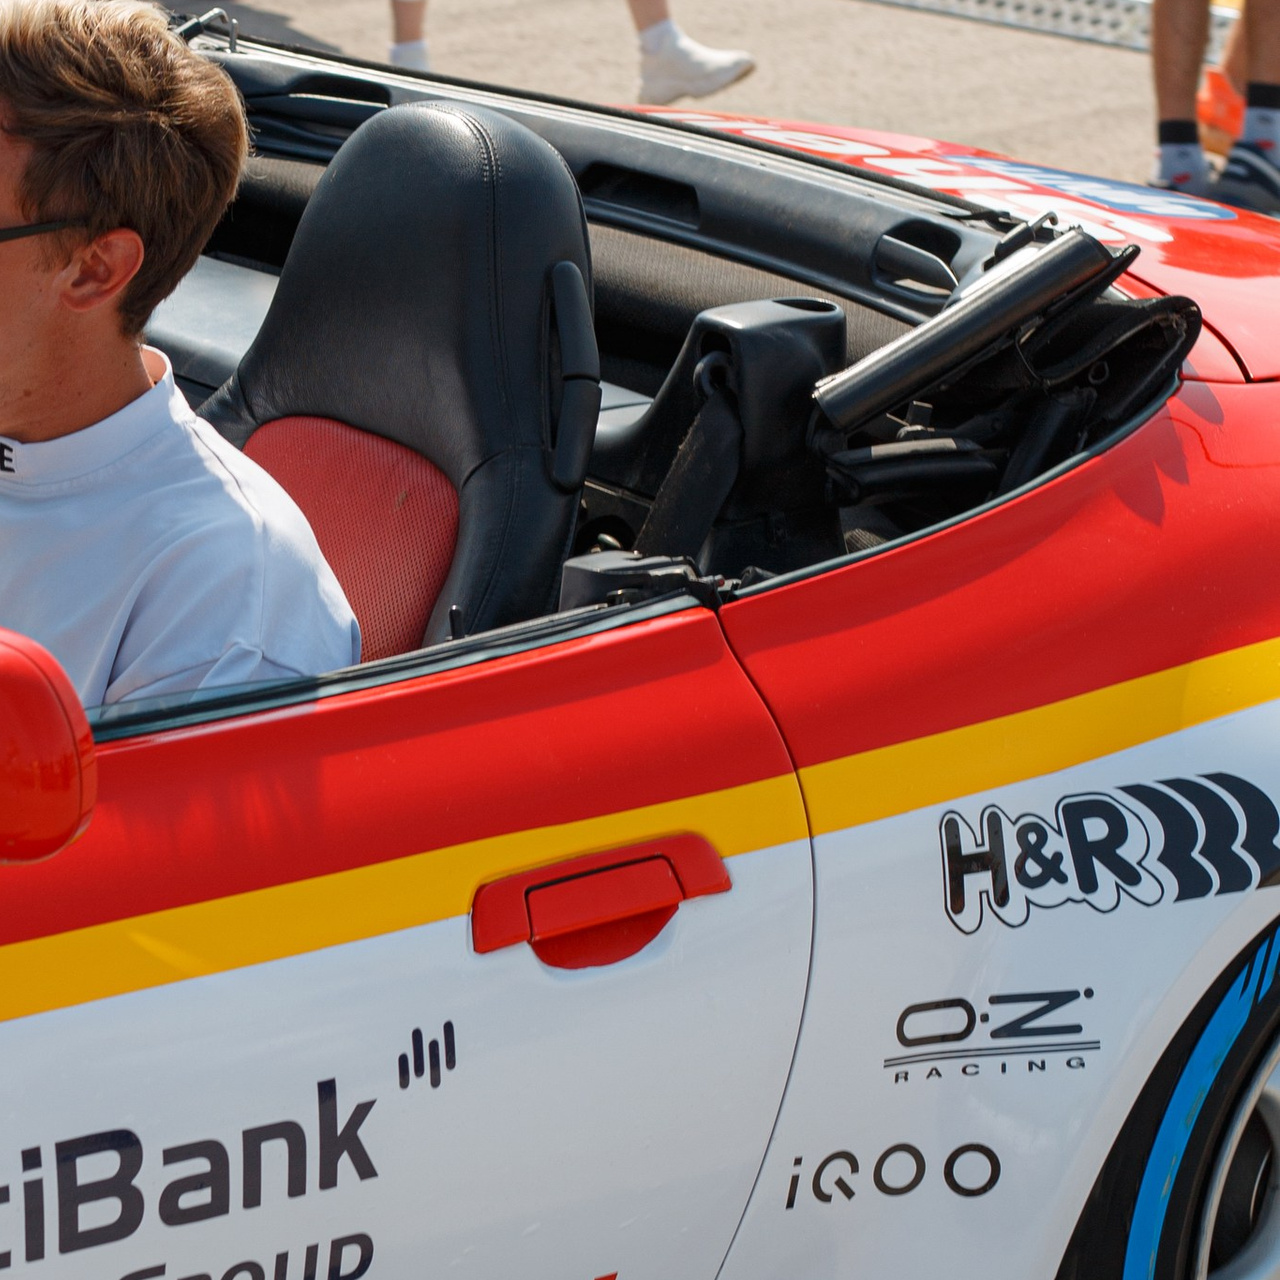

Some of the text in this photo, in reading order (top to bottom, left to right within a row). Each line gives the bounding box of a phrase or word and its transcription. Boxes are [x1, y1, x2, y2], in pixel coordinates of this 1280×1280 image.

[941, 794, 1150, 925] H&R
[894, 1056, 1086, 1084] RACING
[785, 1142, 1001, 1210] iQOO
